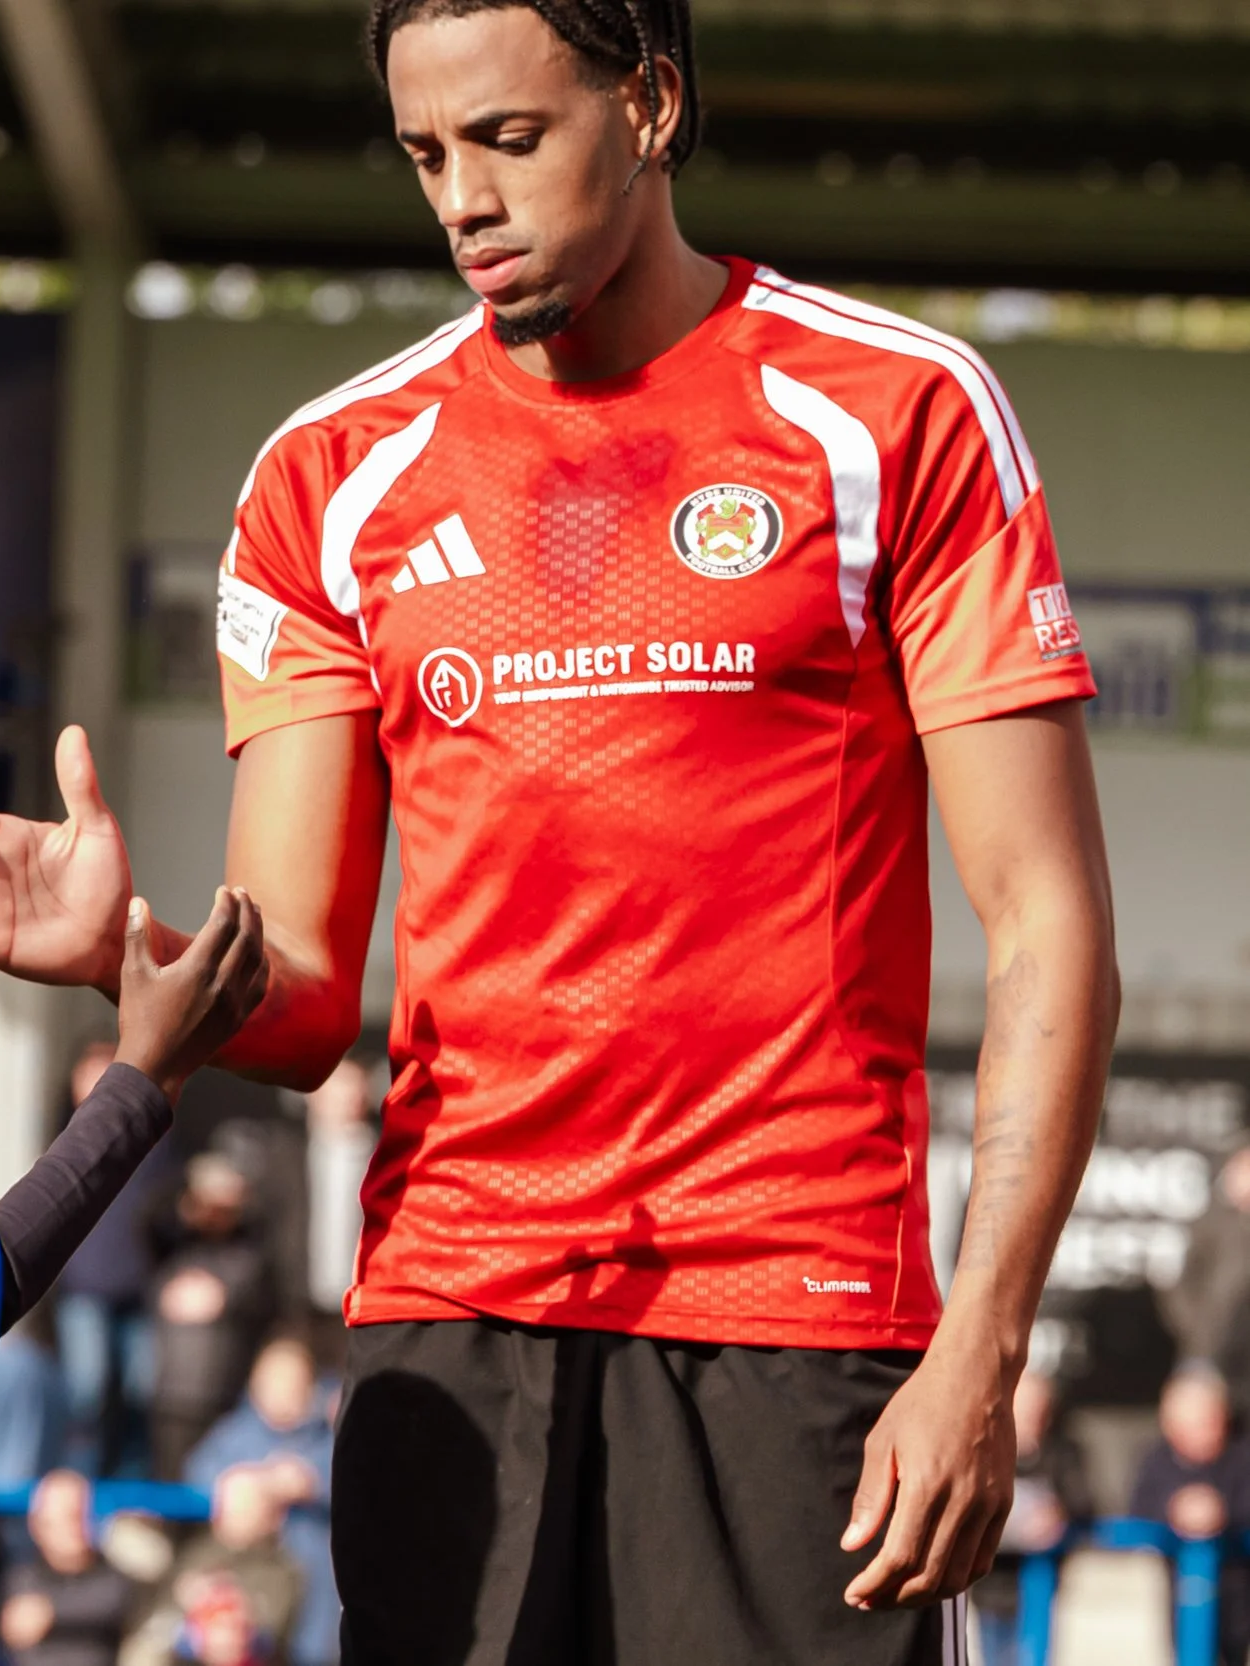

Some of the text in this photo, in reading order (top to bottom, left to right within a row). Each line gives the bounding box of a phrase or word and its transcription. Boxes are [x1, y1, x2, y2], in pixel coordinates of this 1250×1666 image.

[492, 640, 756, 686] PROJECT SOLAR
[663, 679, 710, 693] TRUSTED
[709, 679, 755, 692] ADVISOR
